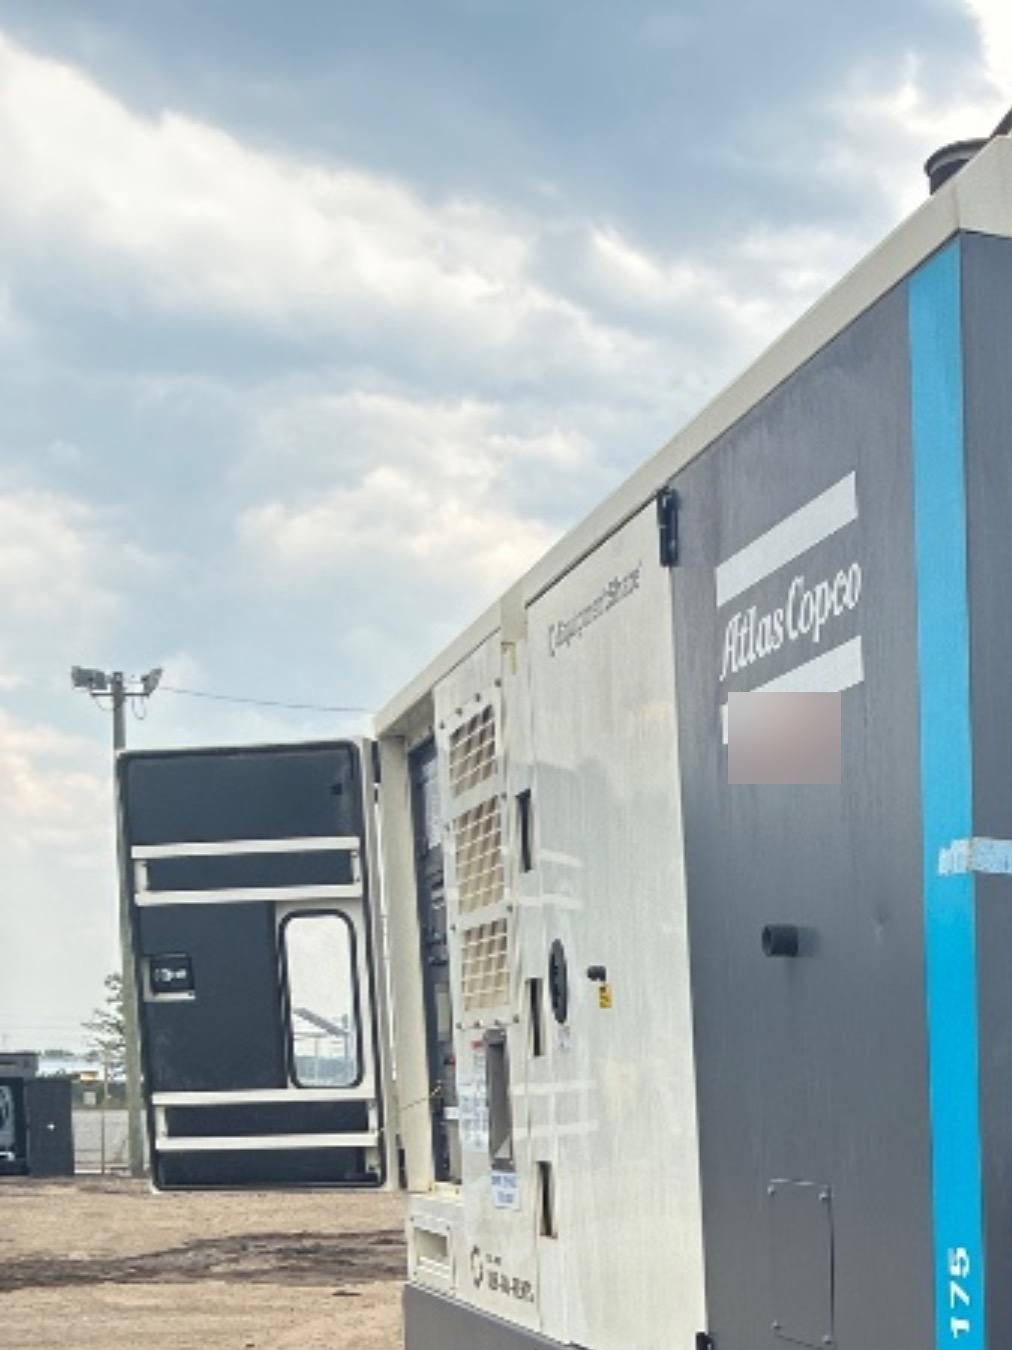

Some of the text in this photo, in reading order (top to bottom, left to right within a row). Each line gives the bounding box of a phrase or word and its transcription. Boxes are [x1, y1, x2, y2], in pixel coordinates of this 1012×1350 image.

[719, 562, 862, 682] Atlas Copco
[948, 1246, 971, 1340] 175
